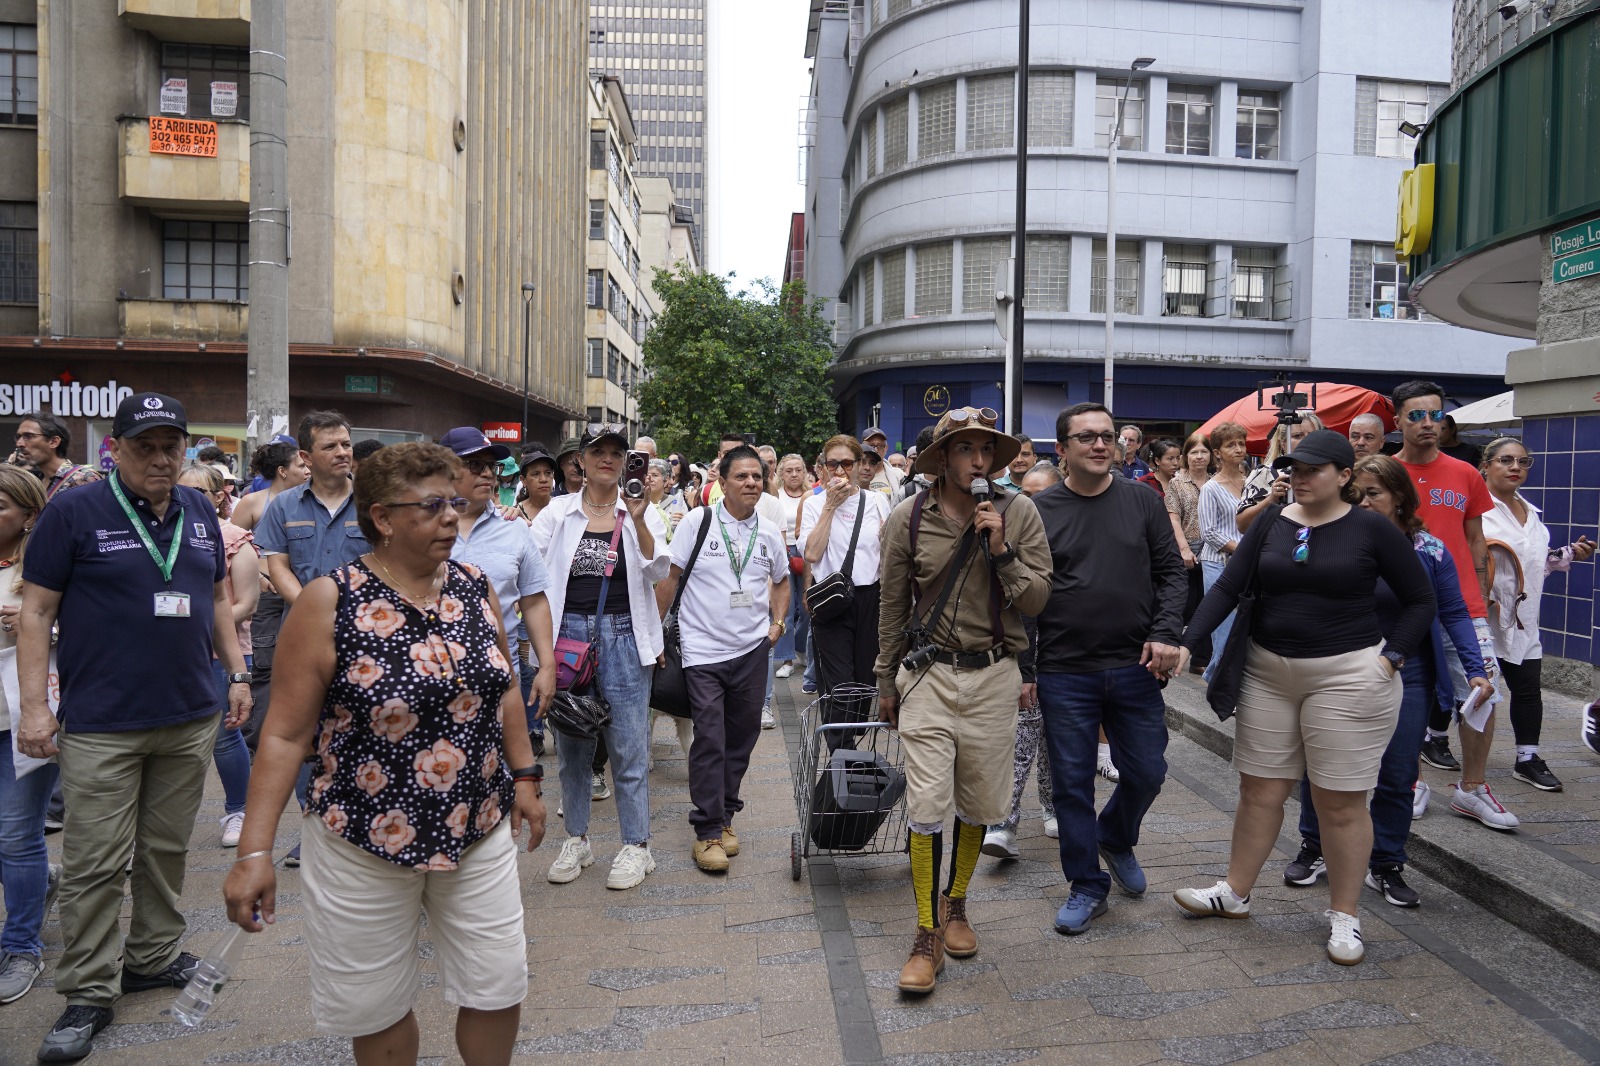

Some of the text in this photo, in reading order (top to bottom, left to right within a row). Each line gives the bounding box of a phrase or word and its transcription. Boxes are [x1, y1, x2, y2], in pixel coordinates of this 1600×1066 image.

[151, 119, 216, 135] SE ARRIENDA
[151, 131, 216, 146] 302 465 5471
[175, 144, 191, 153] 264
[1554, 234, 1584, 252] Pasaje
[1560, 260, 1594, 278] Carrera
[484, 428, 519, 439] surtitodo
[1429, 487, 1467, 513] SOX
[98, 540, 126, 548] COMUNA
